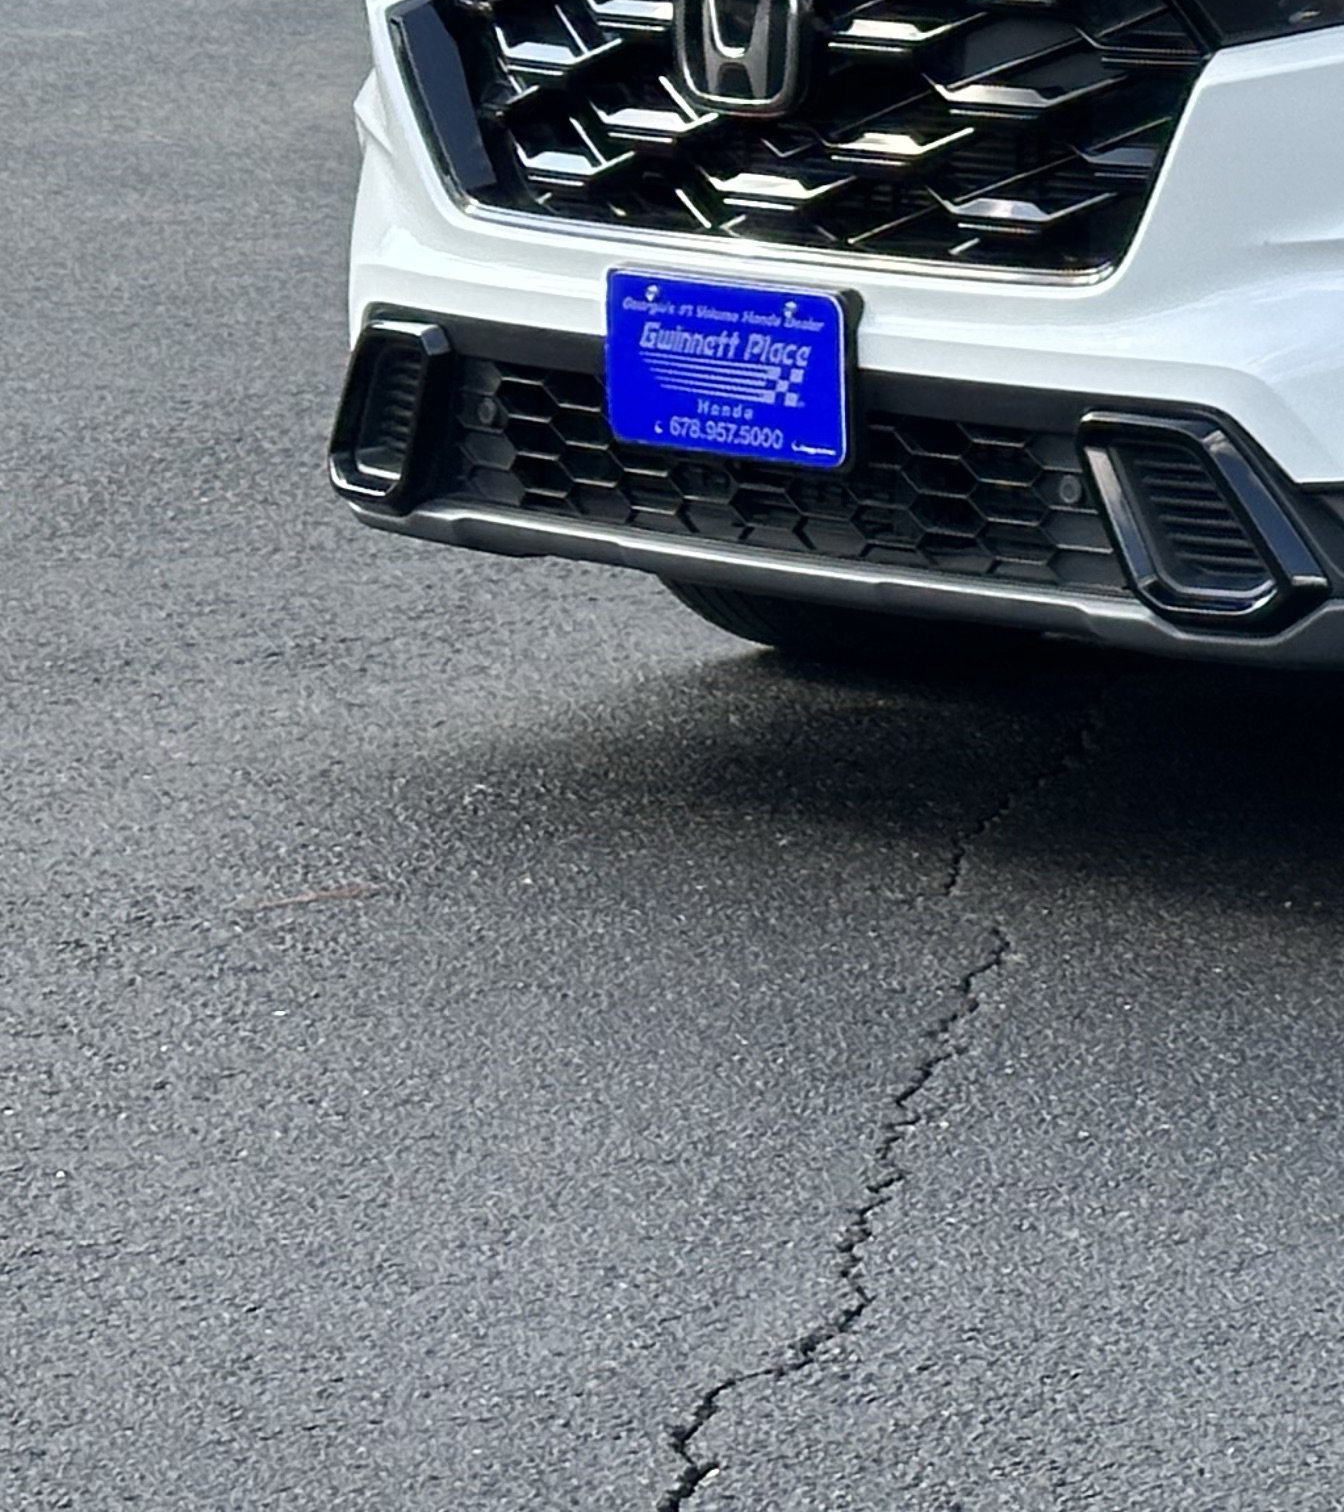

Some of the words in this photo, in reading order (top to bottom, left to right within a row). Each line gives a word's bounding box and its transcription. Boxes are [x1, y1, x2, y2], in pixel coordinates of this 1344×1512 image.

[639, 321, 740, 359] Gwinnett
[743, 333, 812, 367] Place
[697, 399, 754, 419] Honda
[669, 415, 784, 450] 678.957.5000
